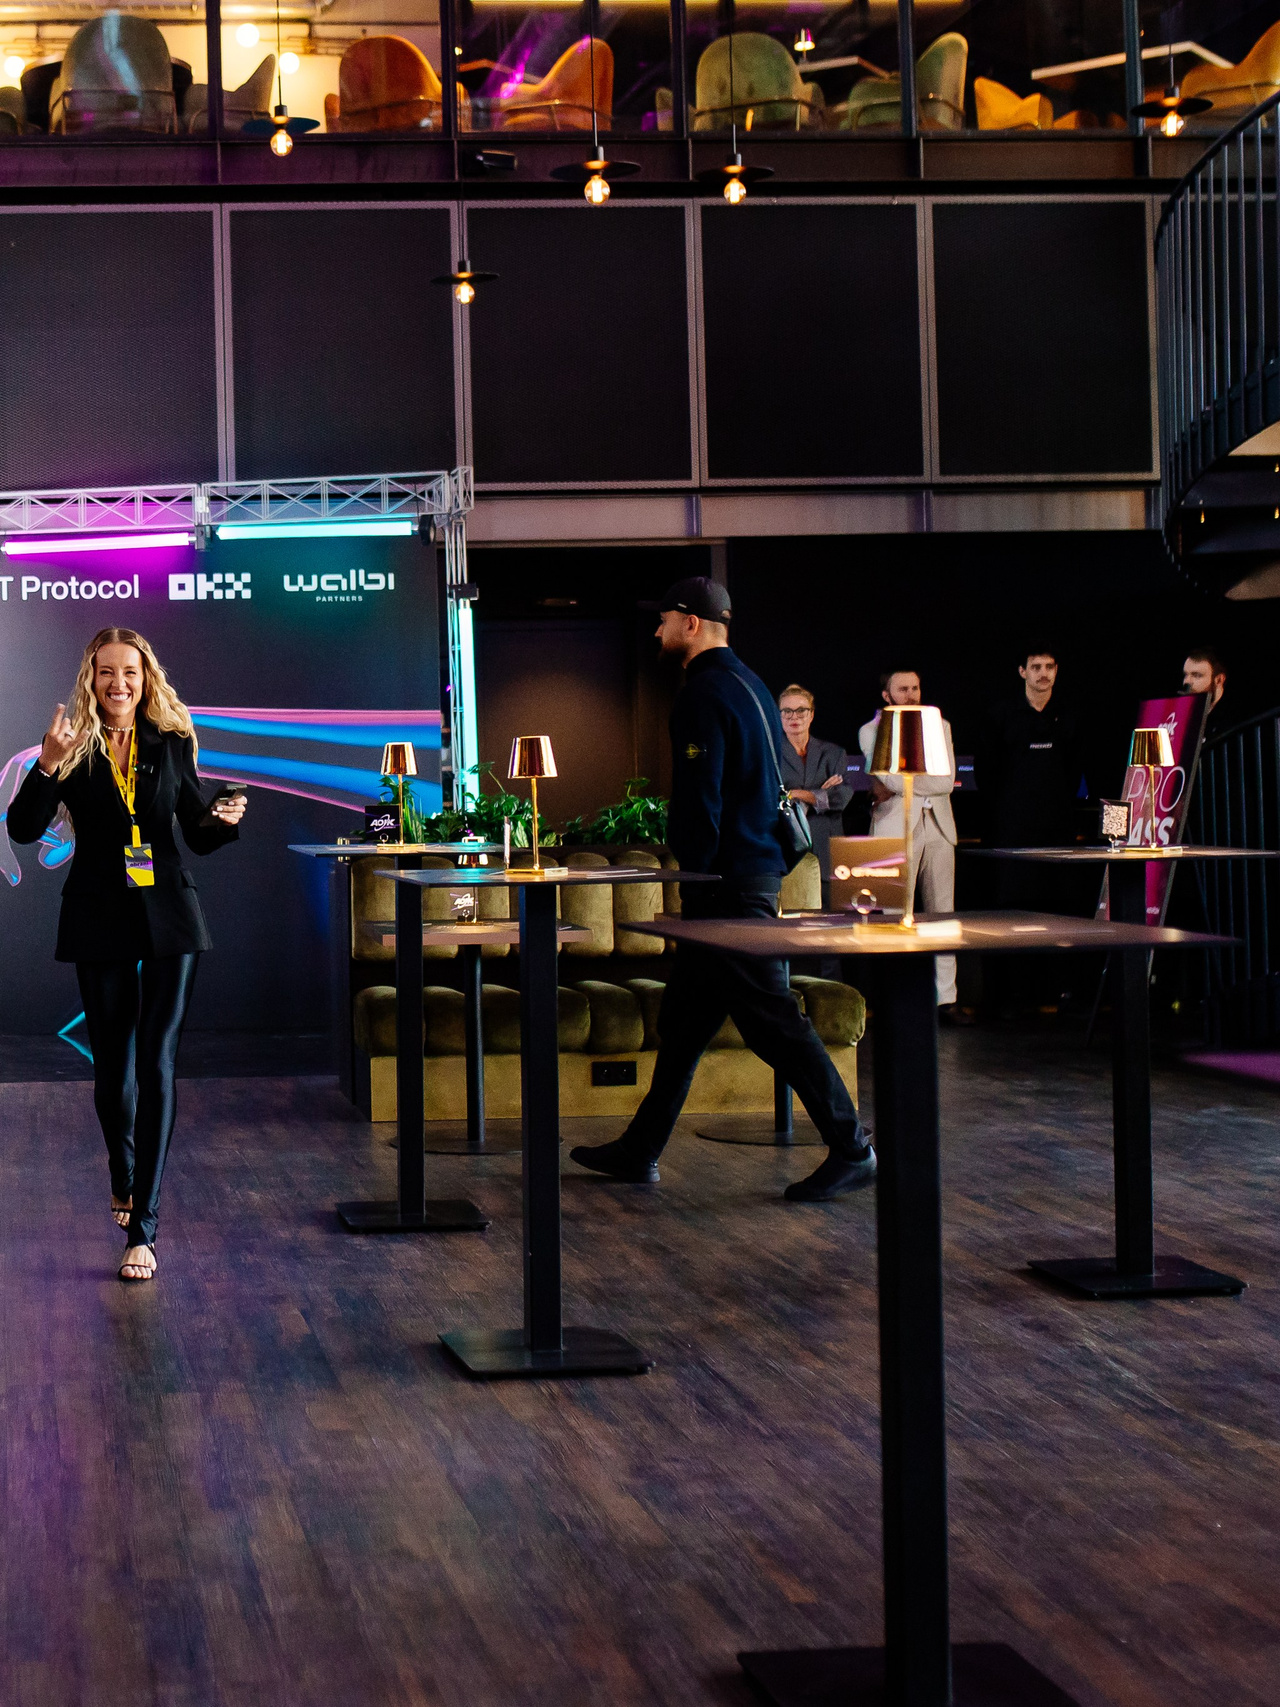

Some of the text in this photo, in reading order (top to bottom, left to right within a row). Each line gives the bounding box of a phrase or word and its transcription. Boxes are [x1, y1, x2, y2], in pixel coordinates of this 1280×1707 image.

[21, 574, 139, 600] Protocol
[169, 573, 251, 600] OKX
[283, 569, 394, 591] walbi
